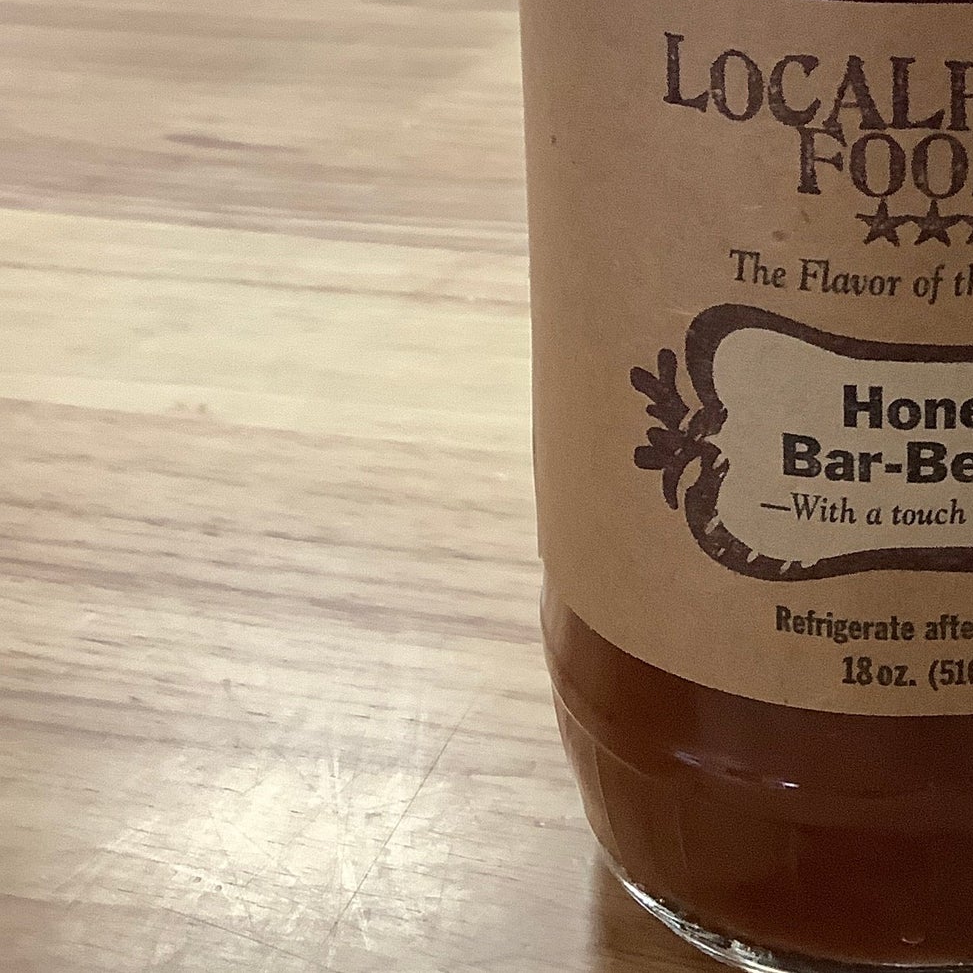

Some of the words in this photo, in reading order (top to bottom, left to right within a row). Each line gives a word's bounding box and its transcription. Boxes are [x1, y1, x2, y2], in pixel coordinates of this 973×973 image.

[730, 249, 786, 289] The
[798, 258, 901, 297] Flavor
[912, 264, 945, 305] of
[866, 506, 883, 526] a
[892, 498, 966, 527] touch
[775, 605, 915, 644] Refrigerate
